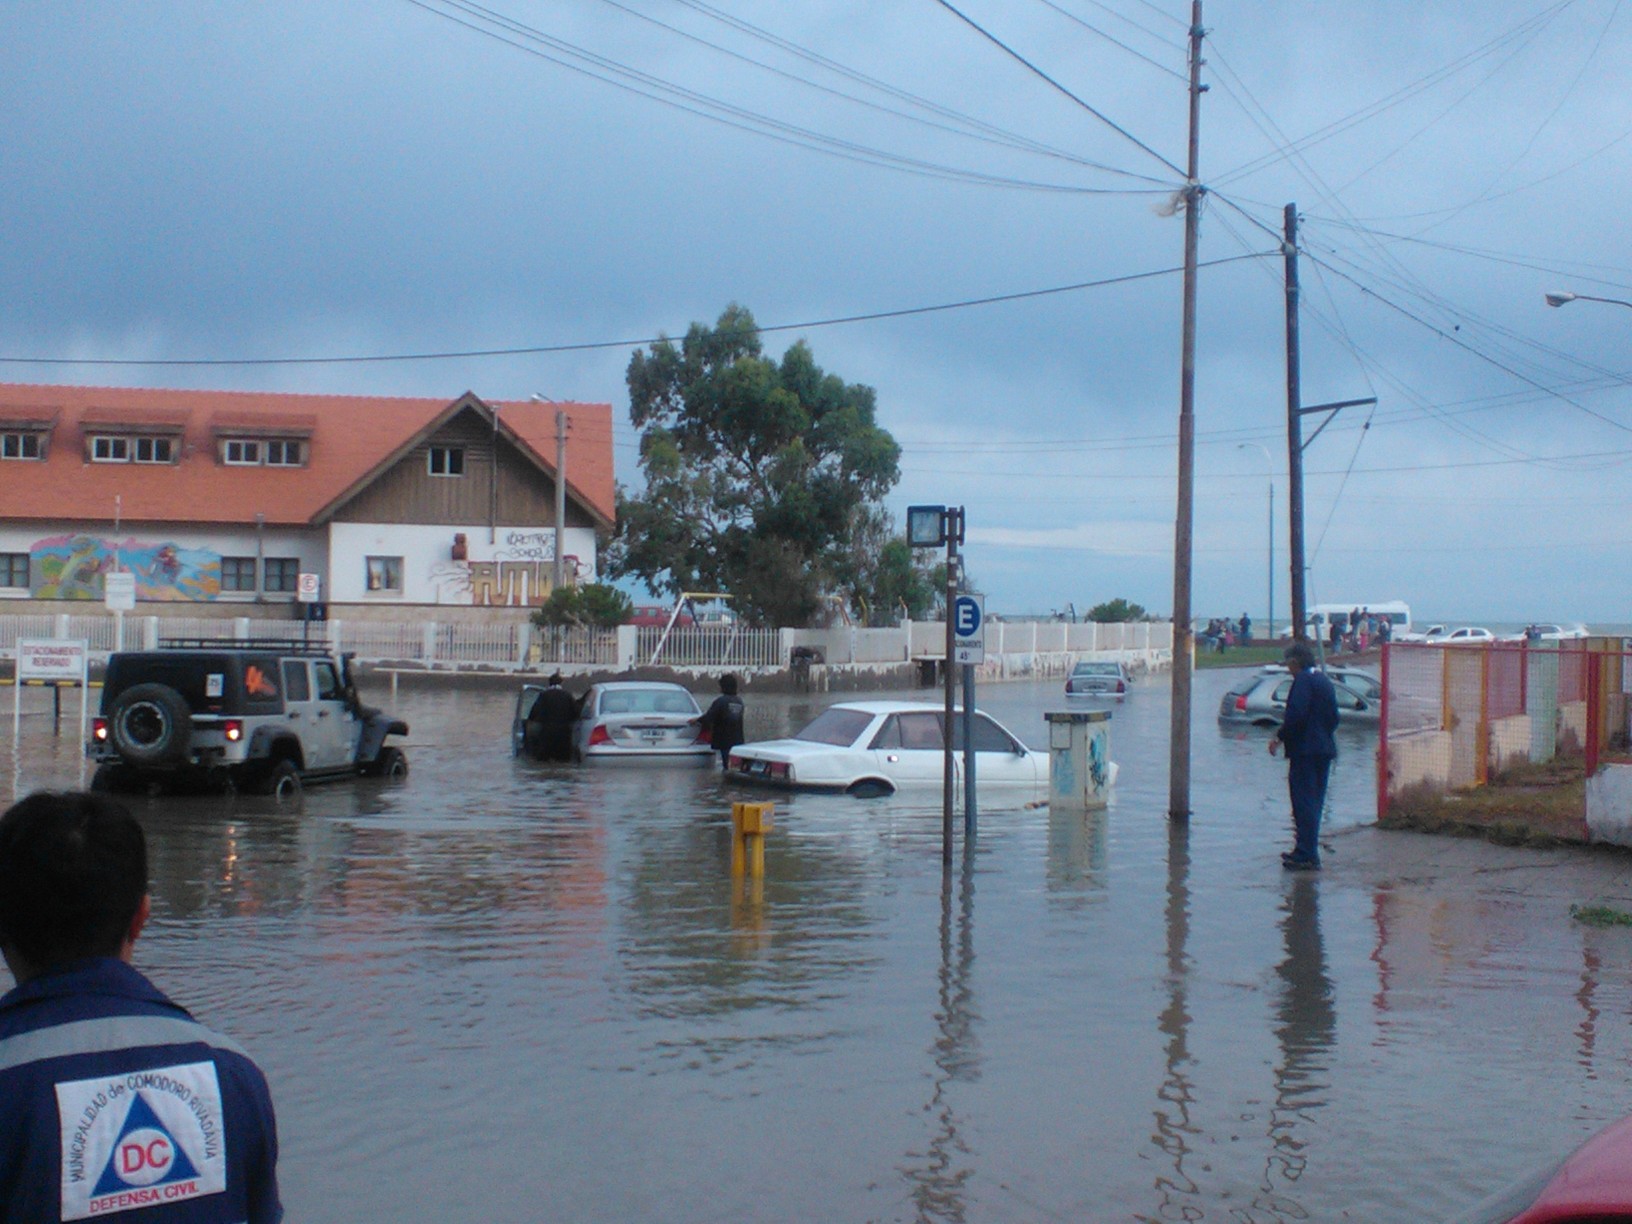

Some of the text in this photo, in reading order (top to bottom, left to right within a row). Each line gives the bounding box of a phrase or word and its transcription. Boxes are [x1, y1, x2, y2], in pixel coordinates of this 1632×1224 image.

[959, 604, 973, 629] E
[70, 1093, 107, 1183] MUNICIPALIDAD
[127, 1074, 191, 1101] COMODORO
[188, 1097, 217, 1160] RIVADAVIA
[122, 1139, 170, 1174] DC
[89, 1181, 199, 1213] DEFENSA CIVIL
